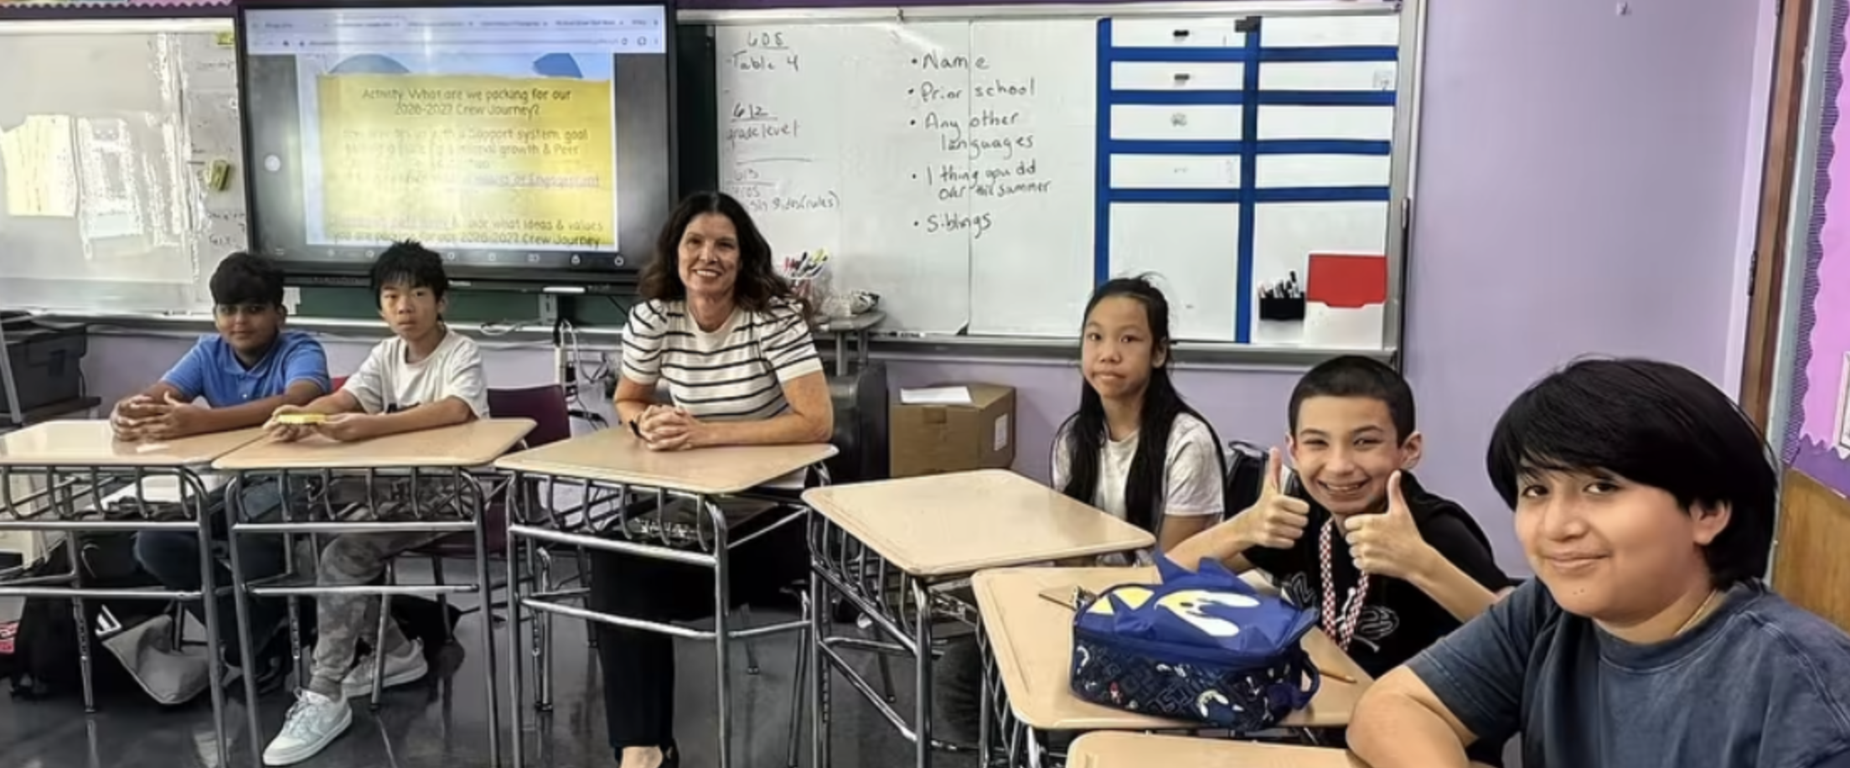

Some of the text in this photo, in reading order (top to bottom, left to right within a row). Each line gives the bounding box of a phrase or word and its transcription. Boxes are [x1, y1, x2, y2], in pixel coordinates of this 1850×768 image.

[787, 54, 799, 71] 4
[922, 50, 990, 70] Name
[406, 88, 441, 100] What
[443, 89, 463, 100] are
[465, 90, 482, 100] we
[485, 88, 528, 104] packing
[531, 87, 549, 100] for
[551, 89, 572, 101] our
[921, 76, 1035, 102] Prior school
[455, 104, 484, 116] Crew
[487, 104, 540, 121] Journey?
[733, 103, 769, 119] 612
[925, 108, 1019, 141] Any other
[564, 128, 589, 144] goal
[500, 144, 539, 159] growth
[941, 133, 1034, 161] languages
[940, 164, 979, 190] thing
[997, 180, 1052, 198] summer
[523, 218, 554, 231] ideas
[926, 212, 992, 239] Siblings
[522, 232, 551, 245] Crew
